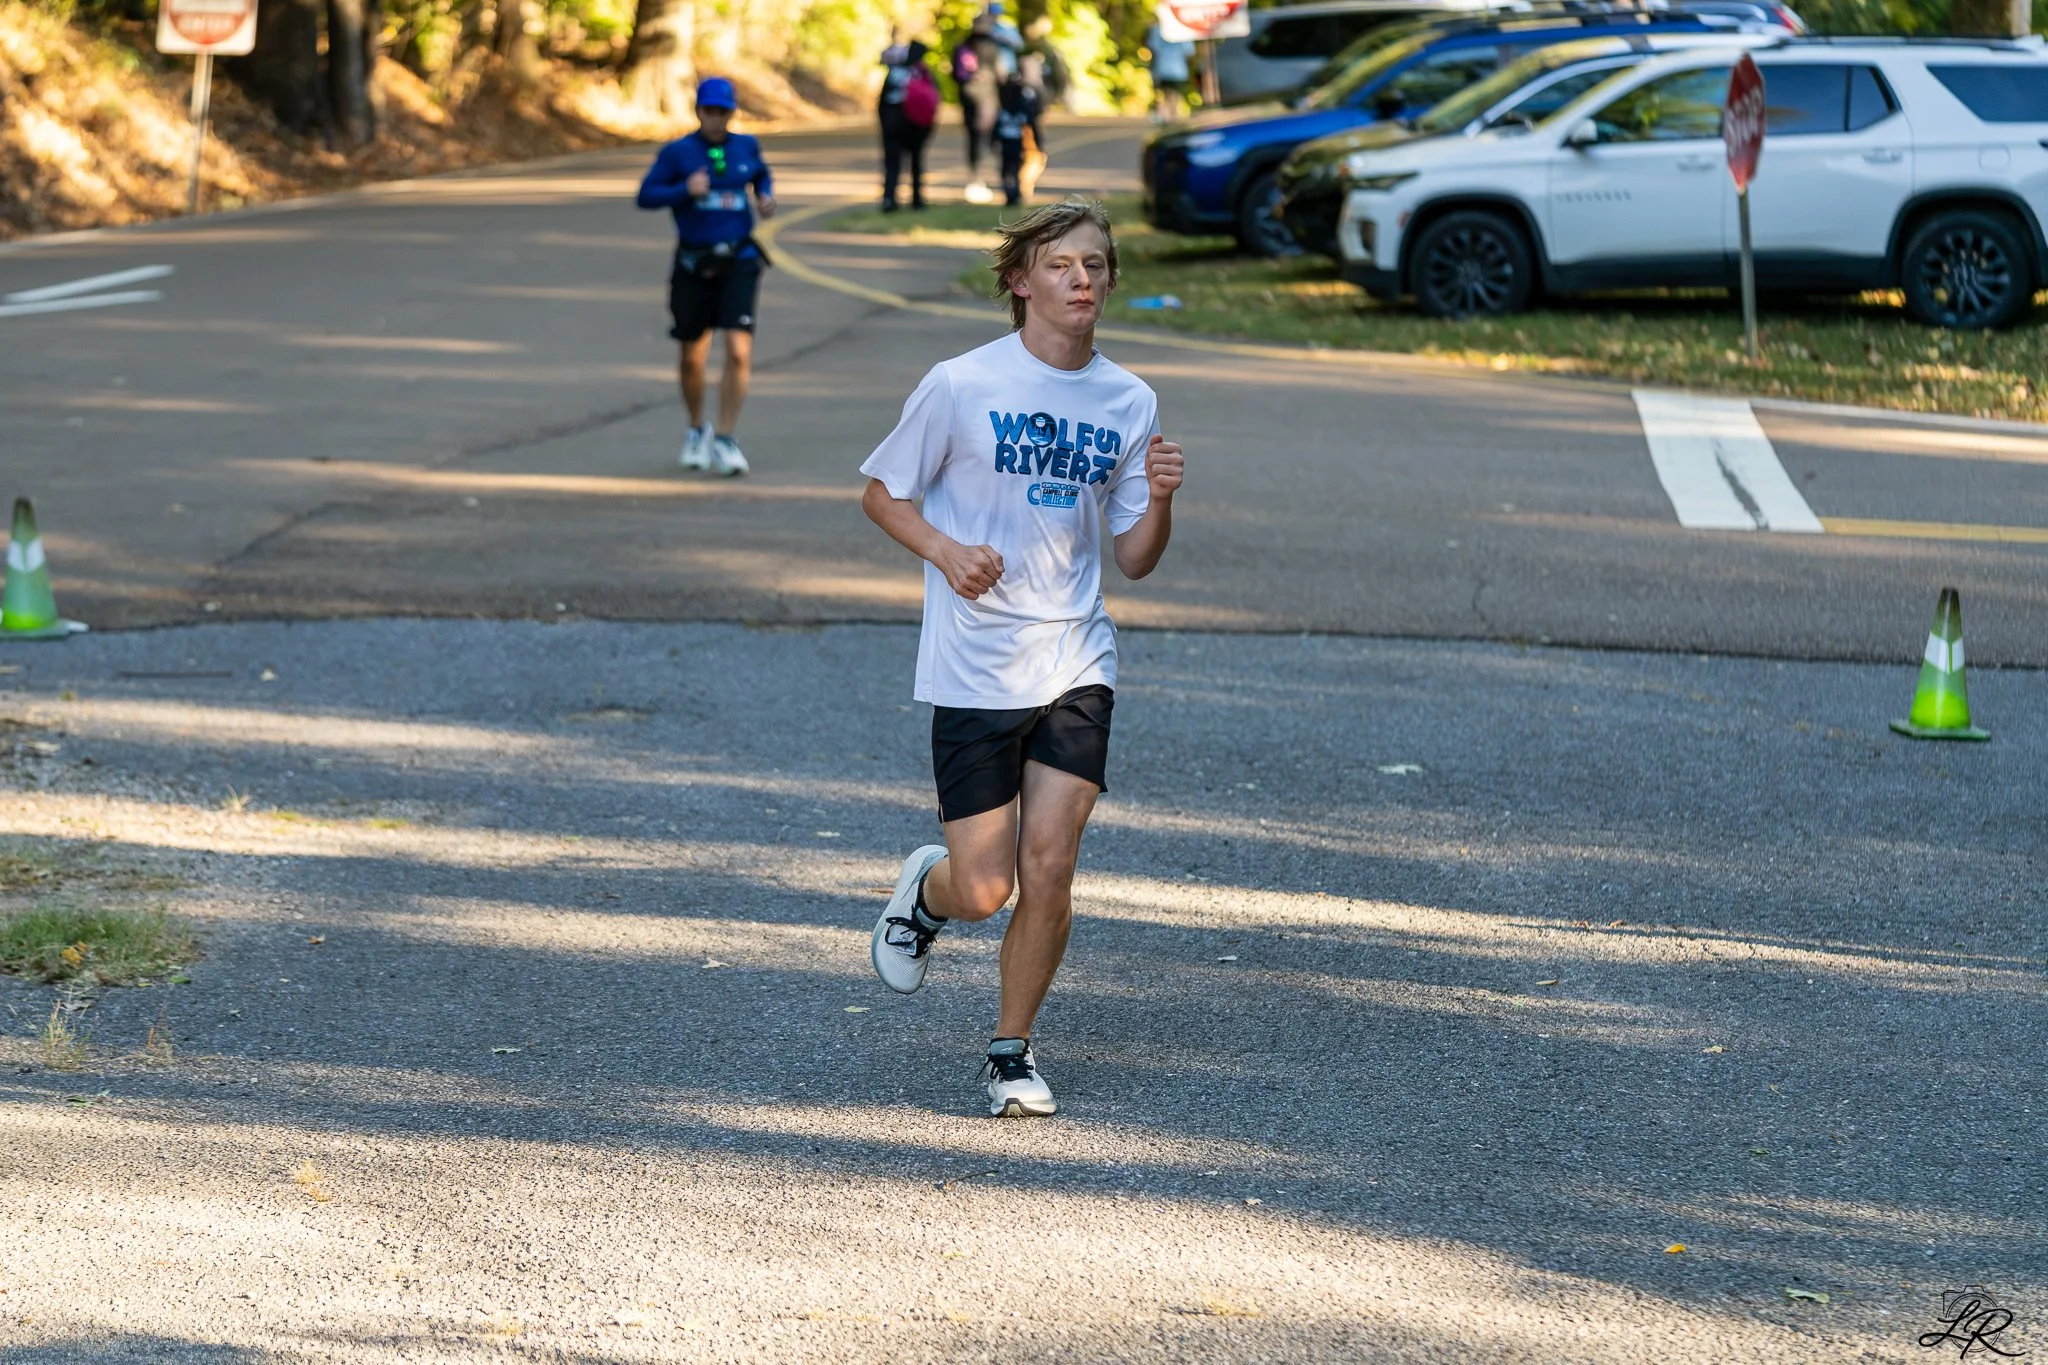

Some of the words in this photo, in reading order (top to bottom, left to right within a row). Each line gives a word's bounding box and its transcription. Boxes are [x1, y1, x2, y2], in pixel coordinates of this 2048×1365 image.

[989, 410, 1095, 454] WOLF
[994, 442, 1091, 484] RIVER
[1041, 494, 1078, 506] COLLECTION
